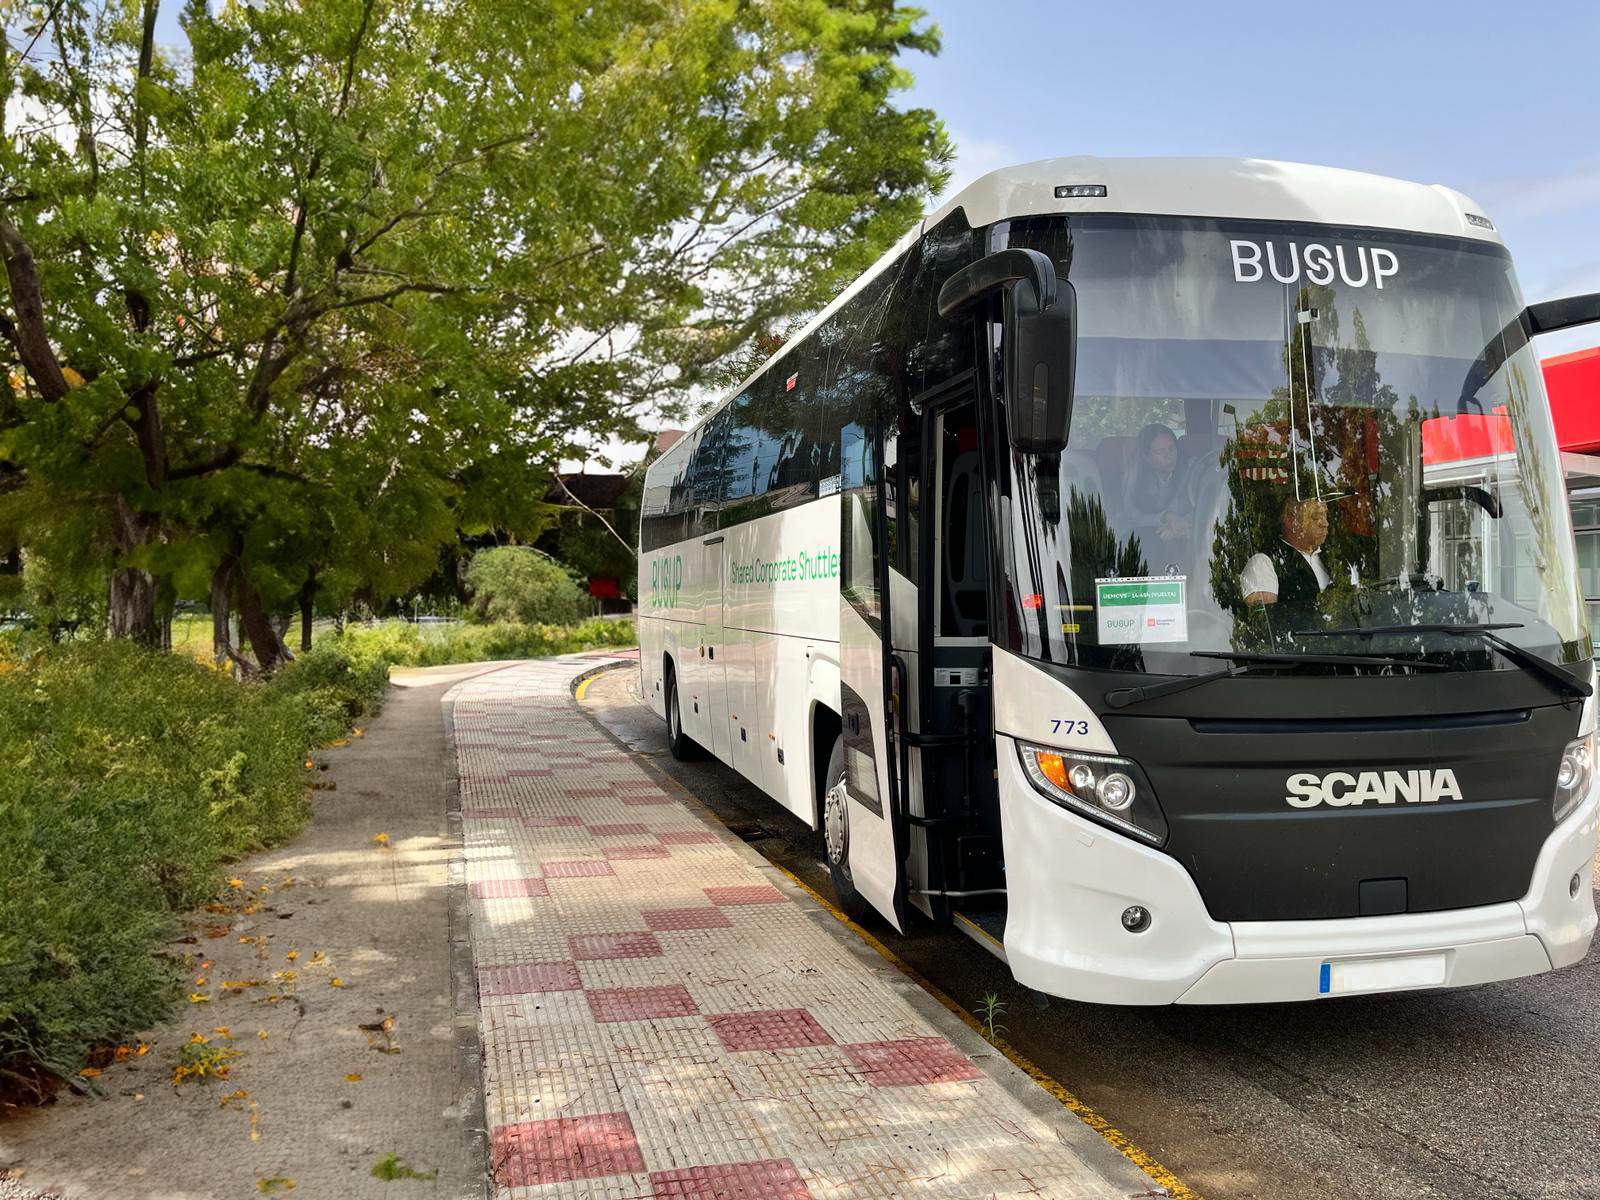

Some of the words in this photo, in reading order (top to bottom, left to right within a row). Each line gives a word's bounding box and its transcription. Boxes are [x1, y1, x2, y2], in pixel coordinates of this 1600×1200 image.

[1230, 239, 1399, 290] BUSUP
[652, 555, 682, 608] BUSUP
[731, 557, 754, 584] Shared
[755, 554, 797, 588] Corporate
[1050, 719, 1089, 735] 773
[1285, 768, 1463, 808] SCANIA
